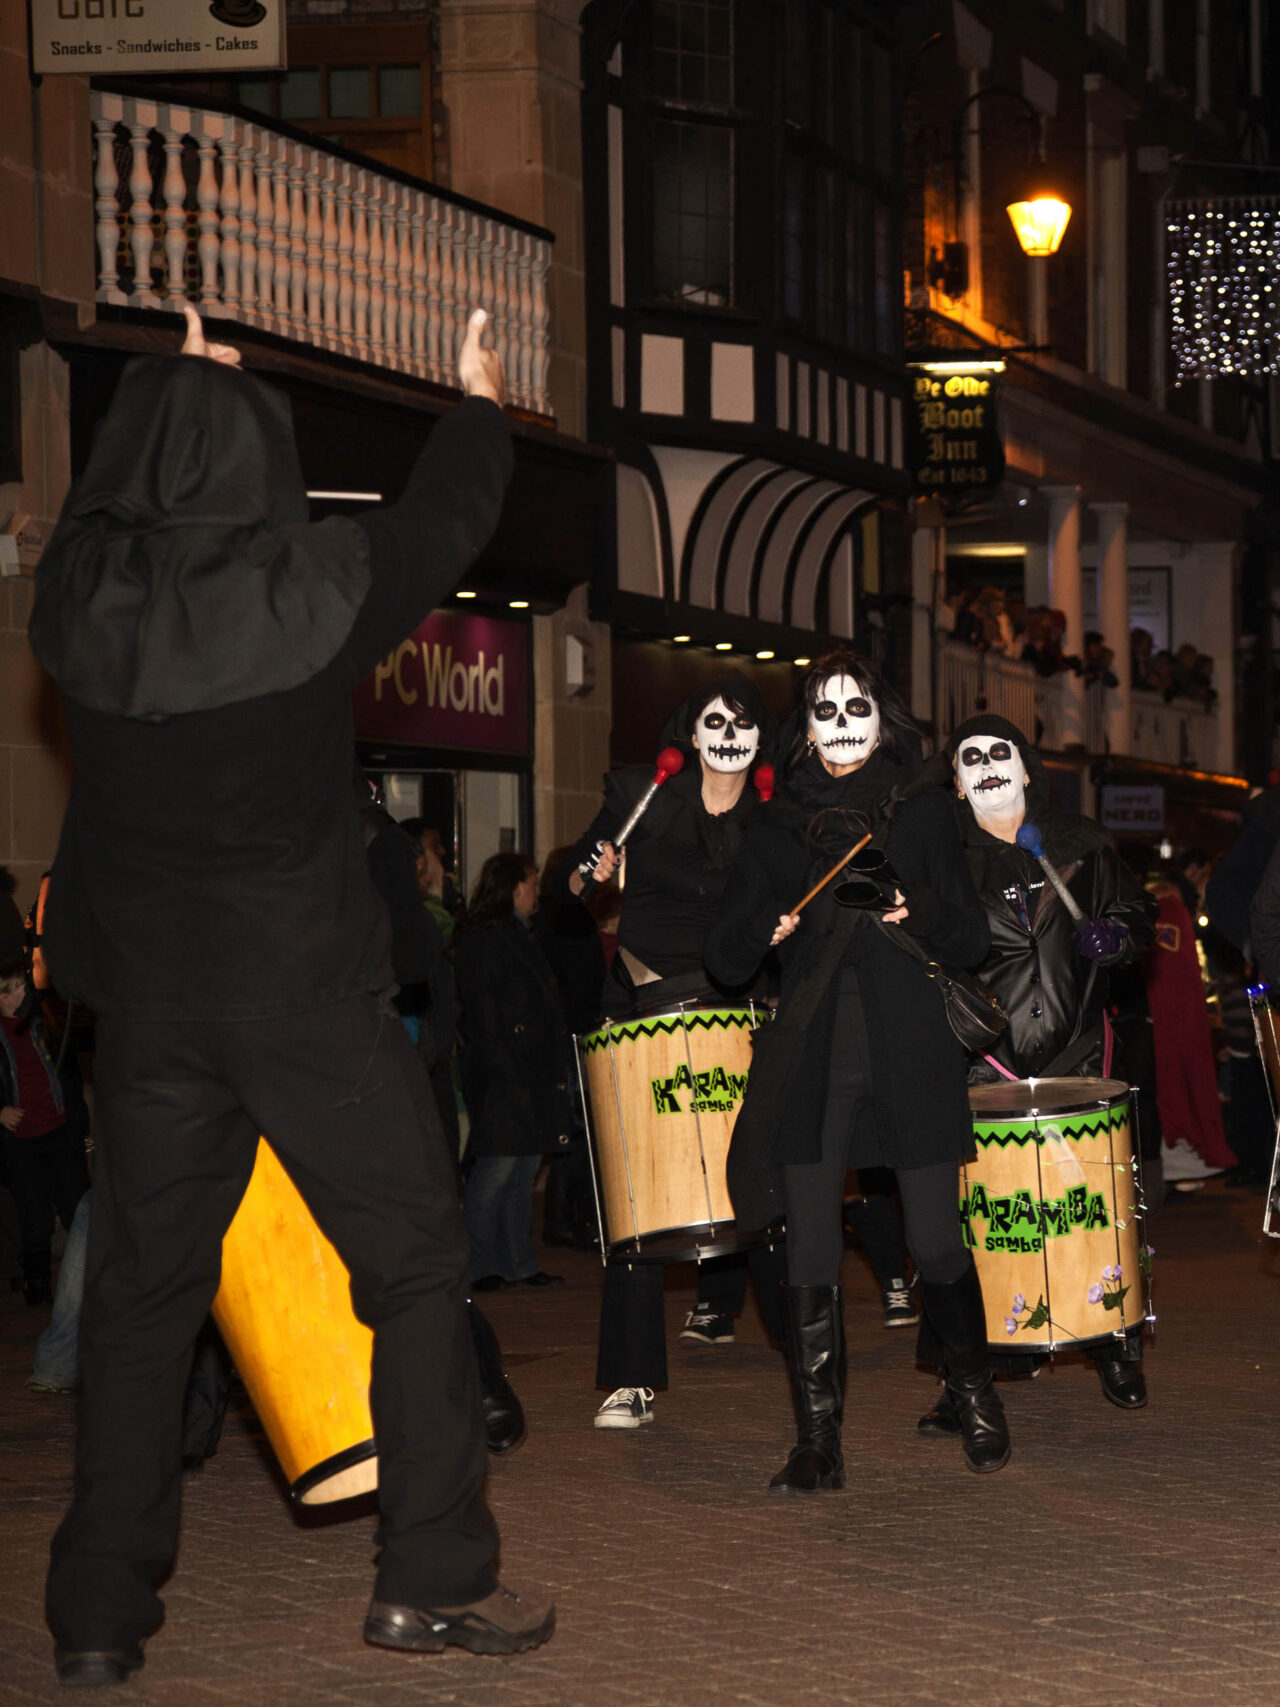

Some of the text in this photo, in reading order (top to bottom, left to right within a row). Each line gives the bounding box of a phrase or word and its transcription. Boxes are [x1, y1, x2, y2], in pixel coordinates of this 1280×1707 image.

[50, 40, 103, 56] Snacks
[116, 38, 201, 55] Sandwiches
[215, 36, 259, 51] Cakes
[913, 376, 990, 402] Ye Olde
[919, 401, 985, 433] Boot
[926, 433, 978, 461] Inn
[374, 638, 505, 716] PC World
[651, 1064, 748, 1114] KARAM
